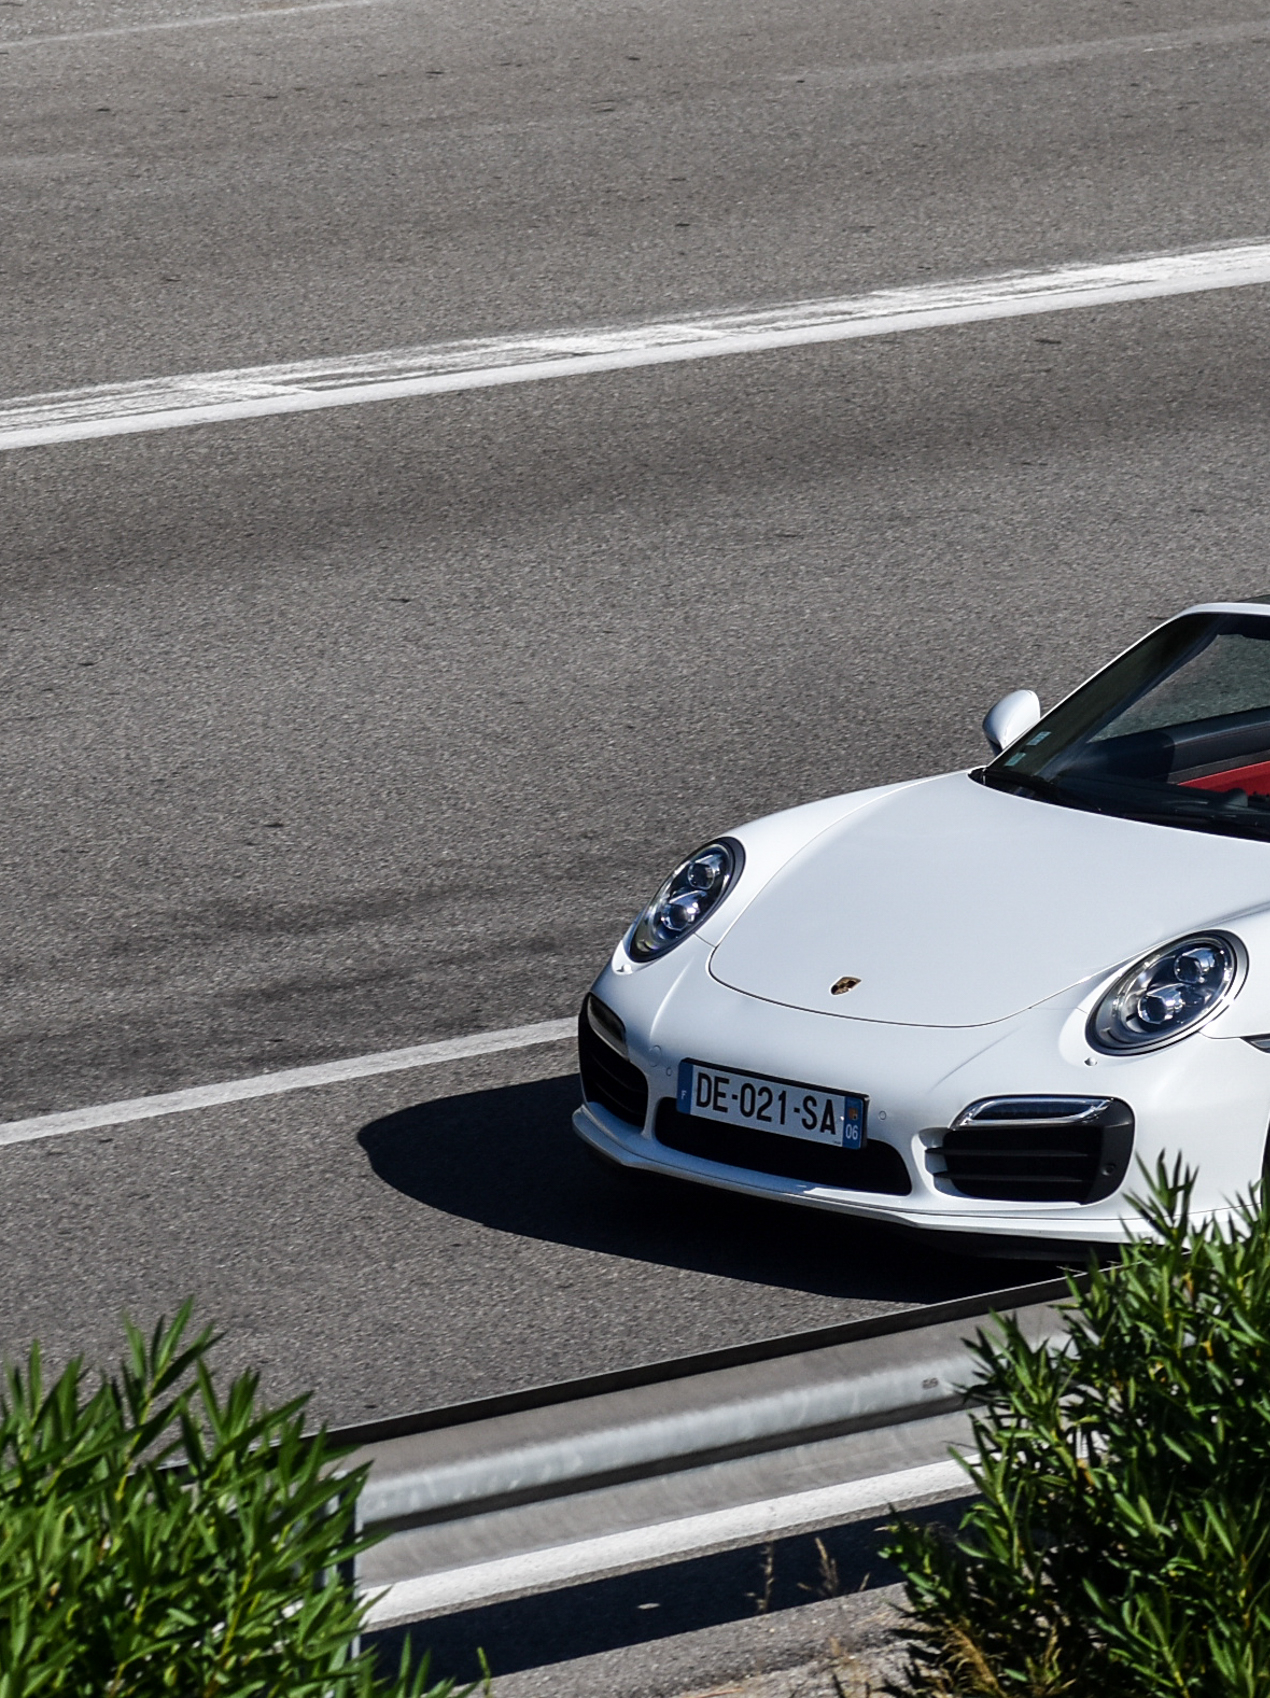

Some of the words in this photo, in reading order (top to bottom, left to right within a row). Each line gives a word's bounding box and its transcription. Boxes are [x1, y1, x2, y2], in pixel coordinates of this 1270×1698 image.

[681, 1090, 688, 1100] F
[696, 1072, 836, 1135] DE-021-SA
[845, 1123, 859, 1140] 06
